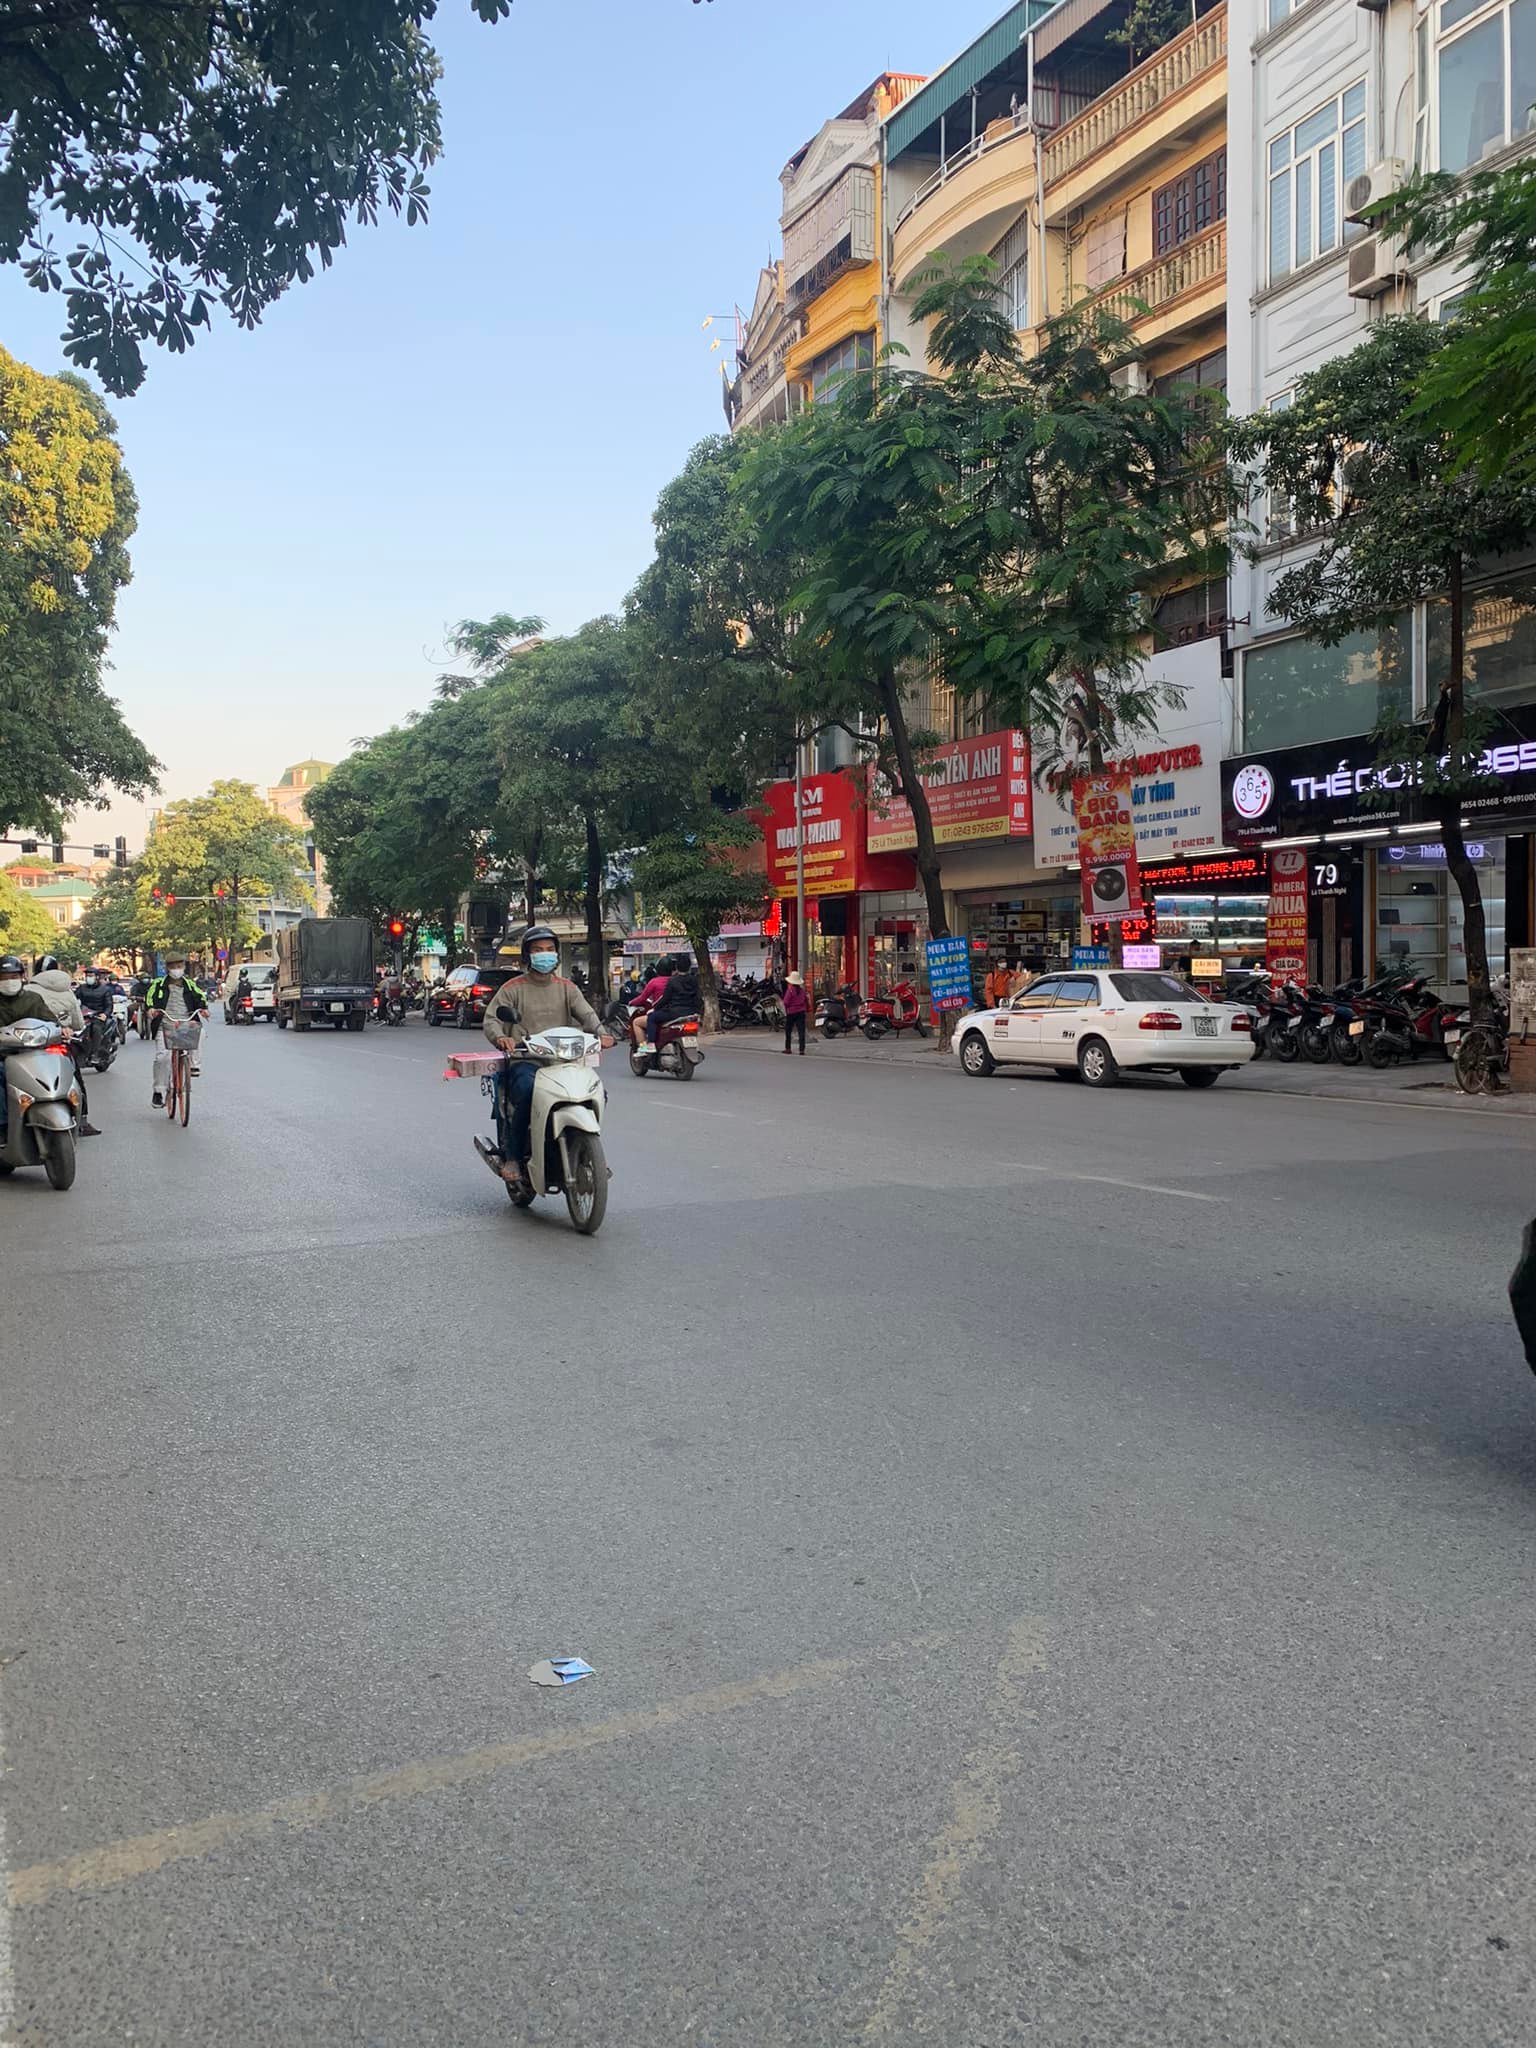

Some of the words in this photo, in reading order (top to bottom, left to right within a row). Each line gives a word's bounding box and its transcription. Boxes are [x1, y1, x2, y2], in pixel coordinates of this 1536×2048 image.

[972, 745, 1001, 779] ANH
[1291, 759, 1351, 801] THẾ
[1087, 795, 1118, 814] BIG
[1079, 809, 1131, 830] BANG
[1281, 853, 1298, 866] 77
[1315, 864, 1337, 886] 79
[1273, 881, 1305, 894] CAMERA
[1268, 896, 1305, 914] MUA
[1267, 917, 1306, 928] LAPTOP
[927, 943, 946, 955] MUA
[929, 953, 967, 966] LAPTOP
